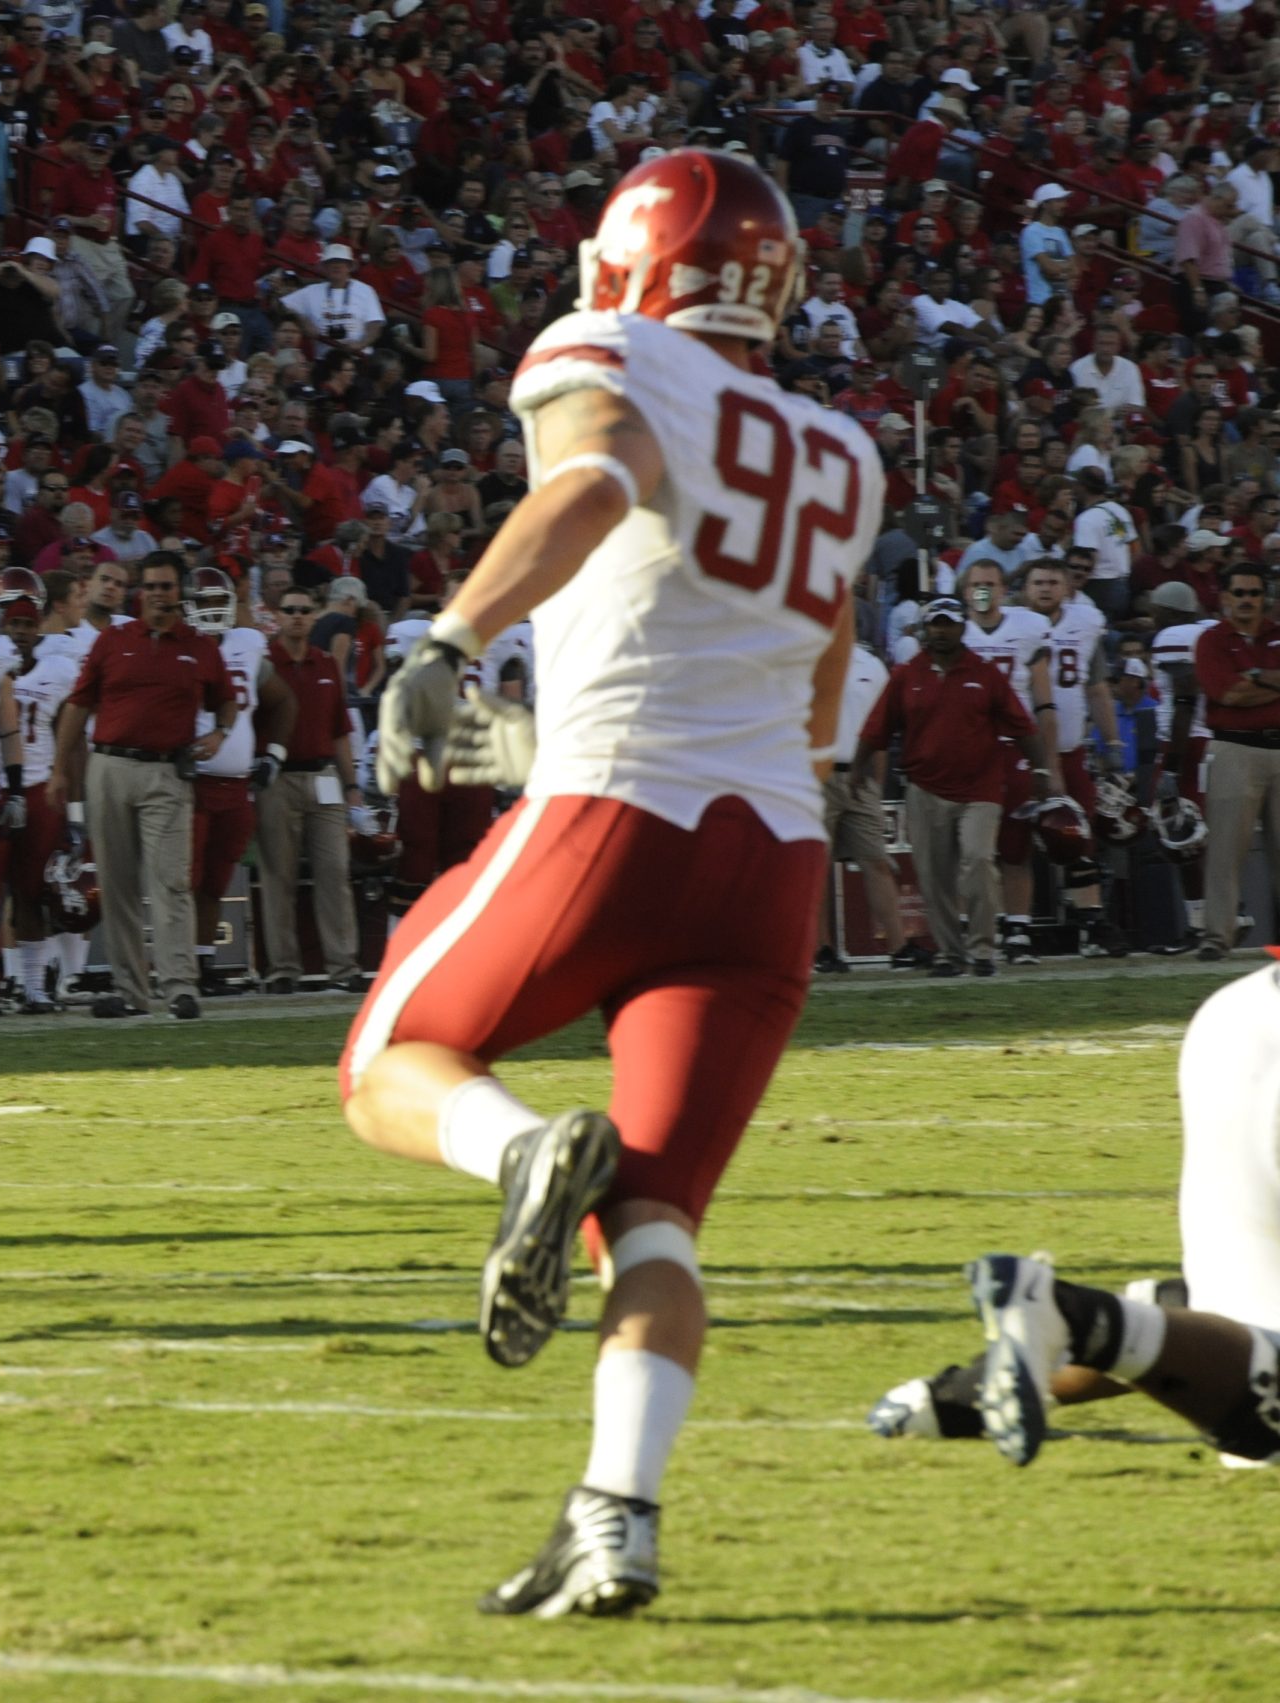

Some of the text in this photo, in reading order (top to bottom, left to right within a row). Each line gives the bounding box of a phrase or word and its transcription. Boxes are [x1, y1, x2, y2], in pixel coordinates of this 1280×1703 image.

[718, 261, 772, 305] 92
[693, 387, 860, 631] 92
[1058, 648, 1078, 689] 8
